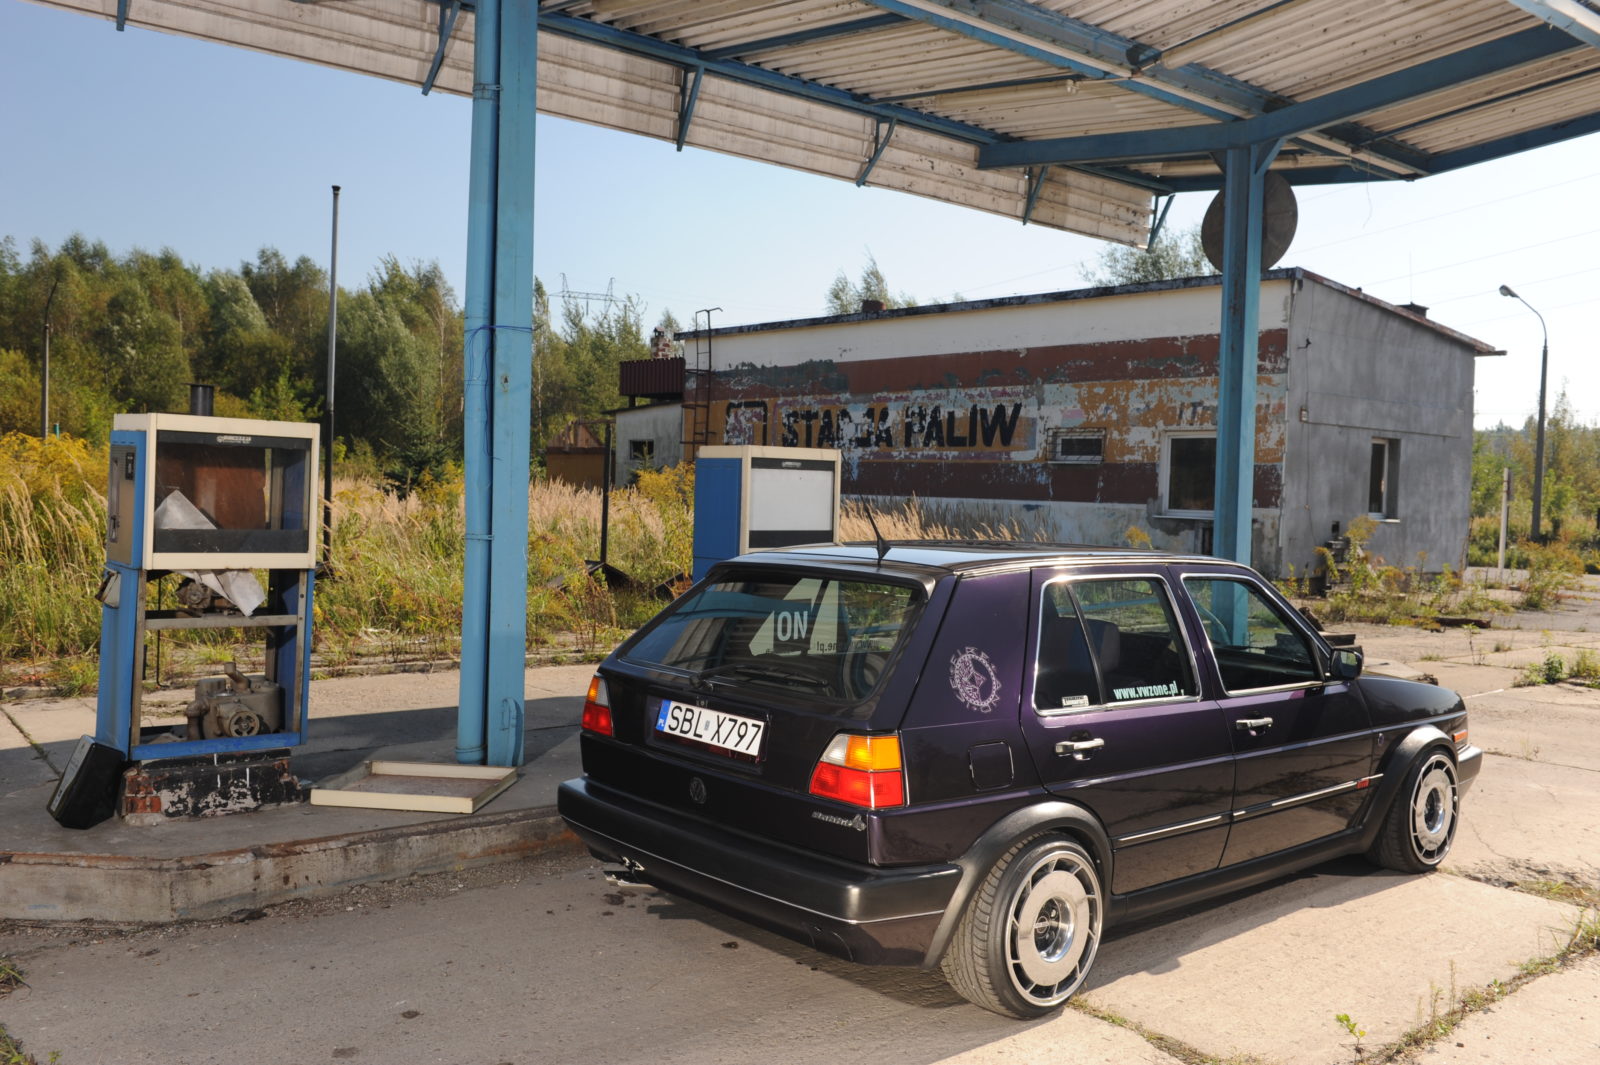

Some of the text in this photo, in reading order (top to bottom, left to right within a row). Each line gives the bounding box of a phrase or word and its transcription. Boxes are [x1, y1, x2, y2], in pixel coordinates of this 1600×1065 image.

[904, 402, 1023, 448] PALIW
[1113, 680, 1179, 700] www.vwzone.pl
[668, 705, 762, 751] SBL X797
